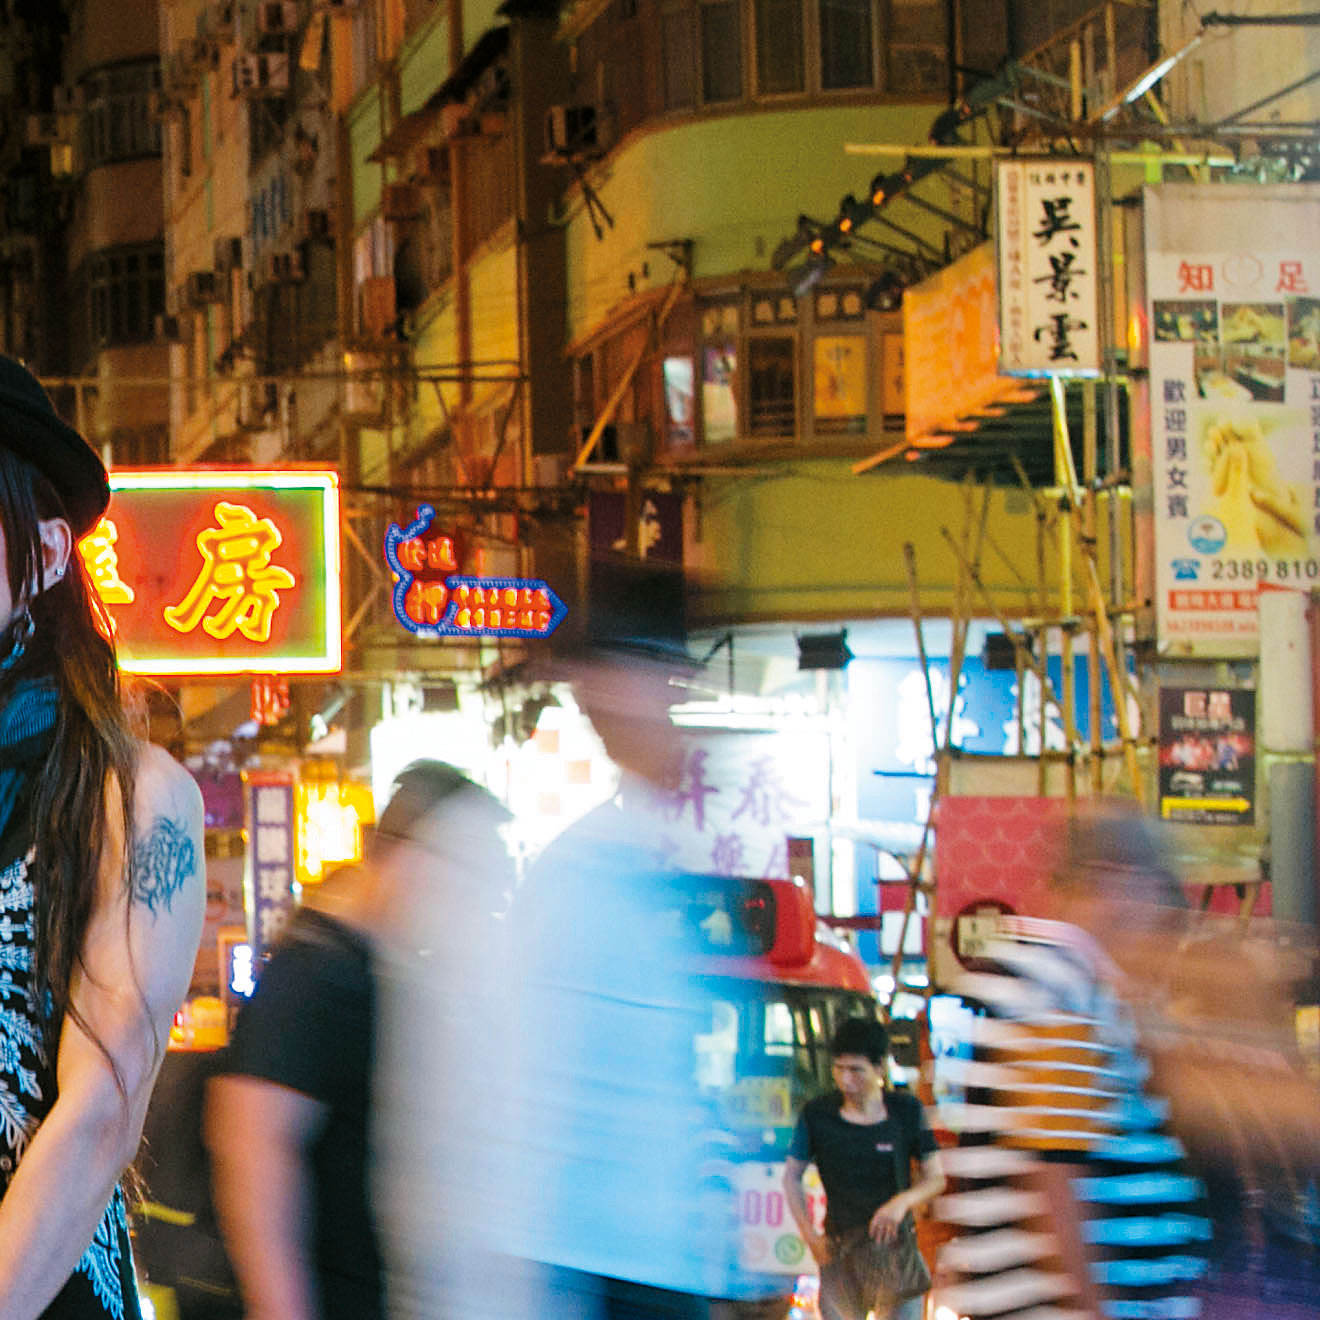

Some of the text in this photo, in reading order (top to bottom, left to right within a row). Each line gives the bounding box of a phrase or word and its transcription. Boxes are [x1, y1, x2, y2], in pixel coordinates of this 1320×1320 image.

[1032, 197, 1088, 361] 吳景雲
[1177, 259, 1309, 293] 知 足
[1211, 559, 1268, 580] 2389
